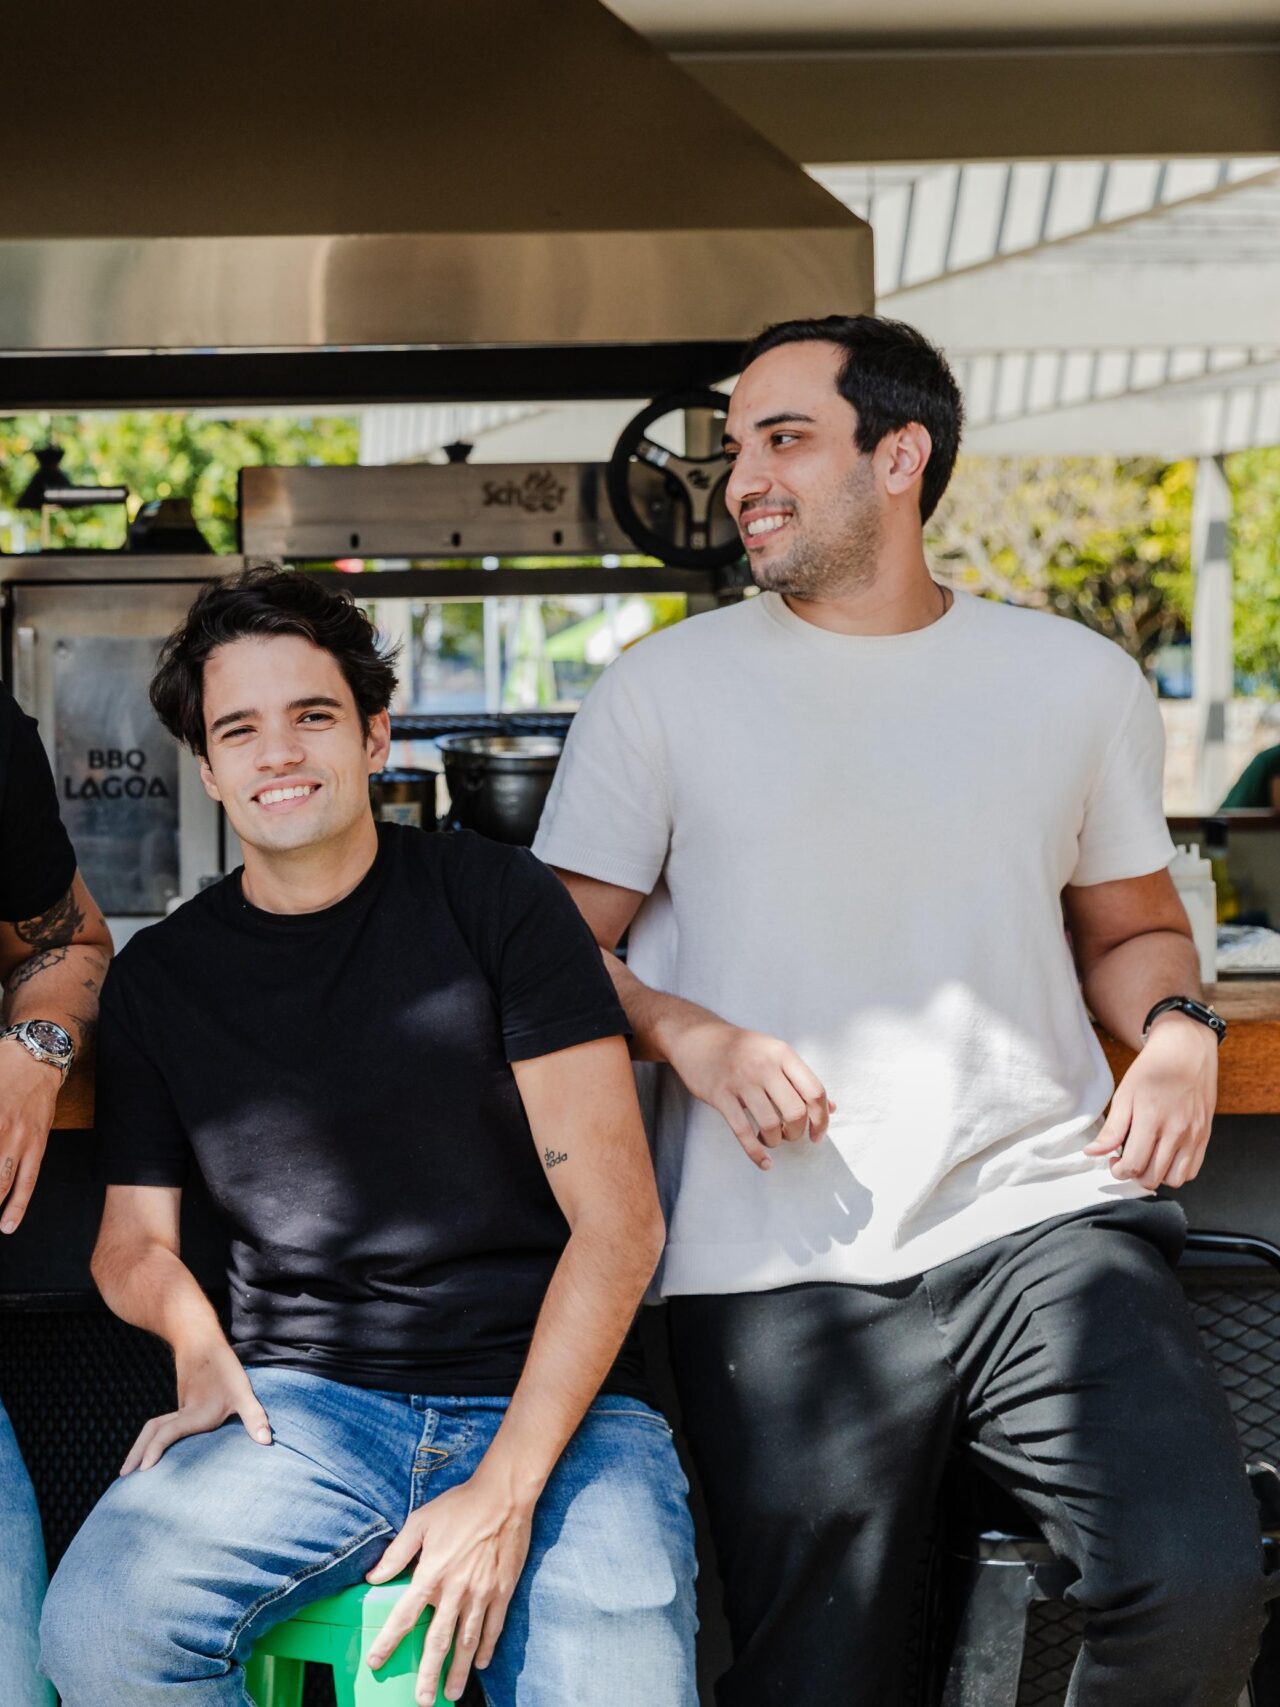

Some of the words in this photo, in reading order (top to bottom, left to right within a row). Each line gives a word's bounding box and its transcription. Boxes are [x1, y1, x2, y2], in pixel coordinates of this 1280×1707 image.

[89, 750, 146, 771] BBQ
[64, 776, 169, 799] LAGOA
[544, 1147, 555, 1161] do
